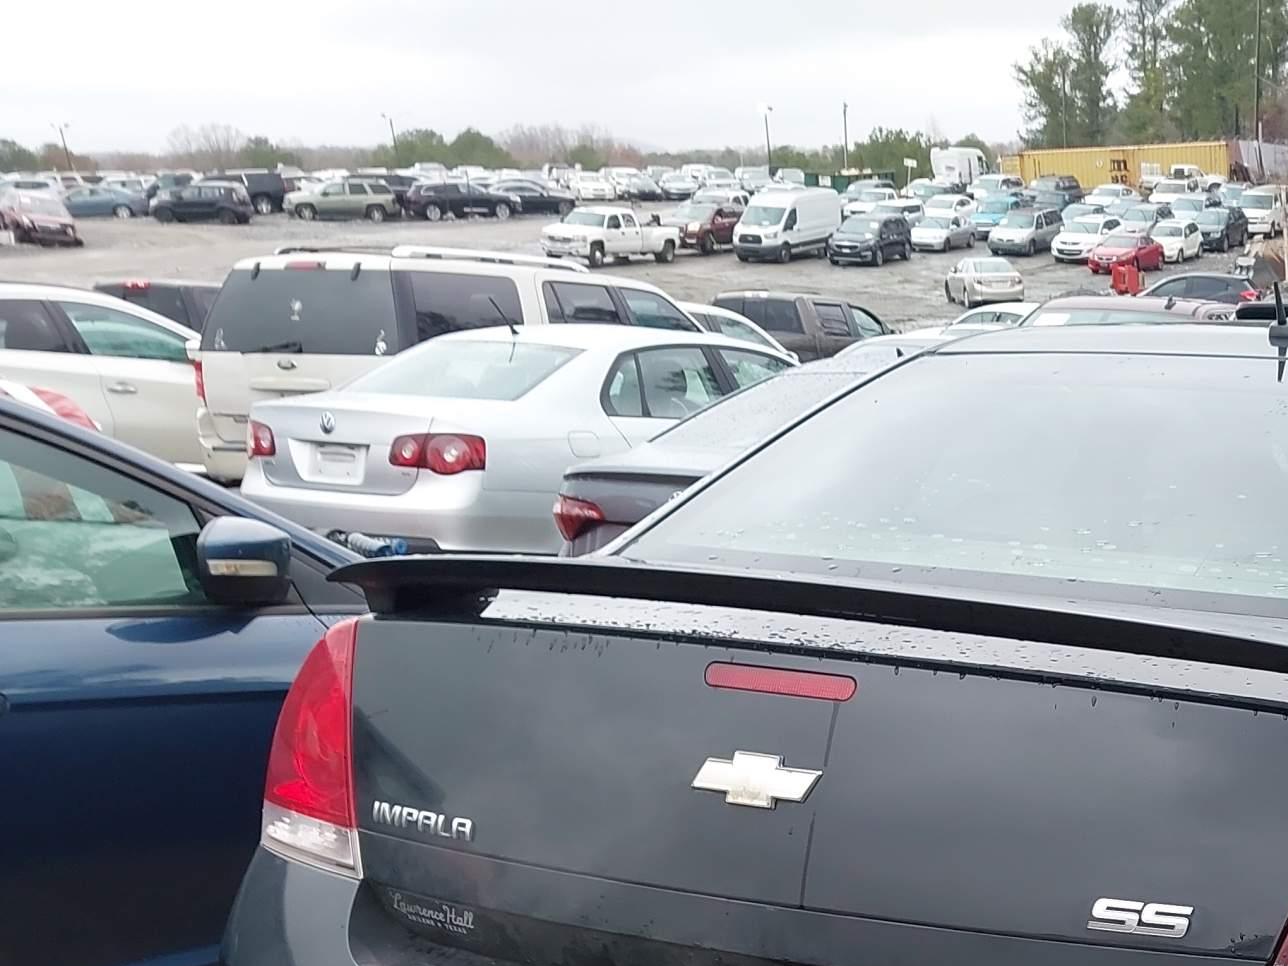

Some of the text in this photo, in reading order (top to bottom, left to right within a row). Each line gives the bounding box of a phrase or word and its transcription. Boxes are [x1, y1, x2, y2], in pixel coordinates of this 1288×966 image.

[373, 800, 473, 841] IMPALA
[389, 892, 446, 922] Lawrence
[442, 904, 475, 929] Hall
[1087, 898, 1194, 938] SS
